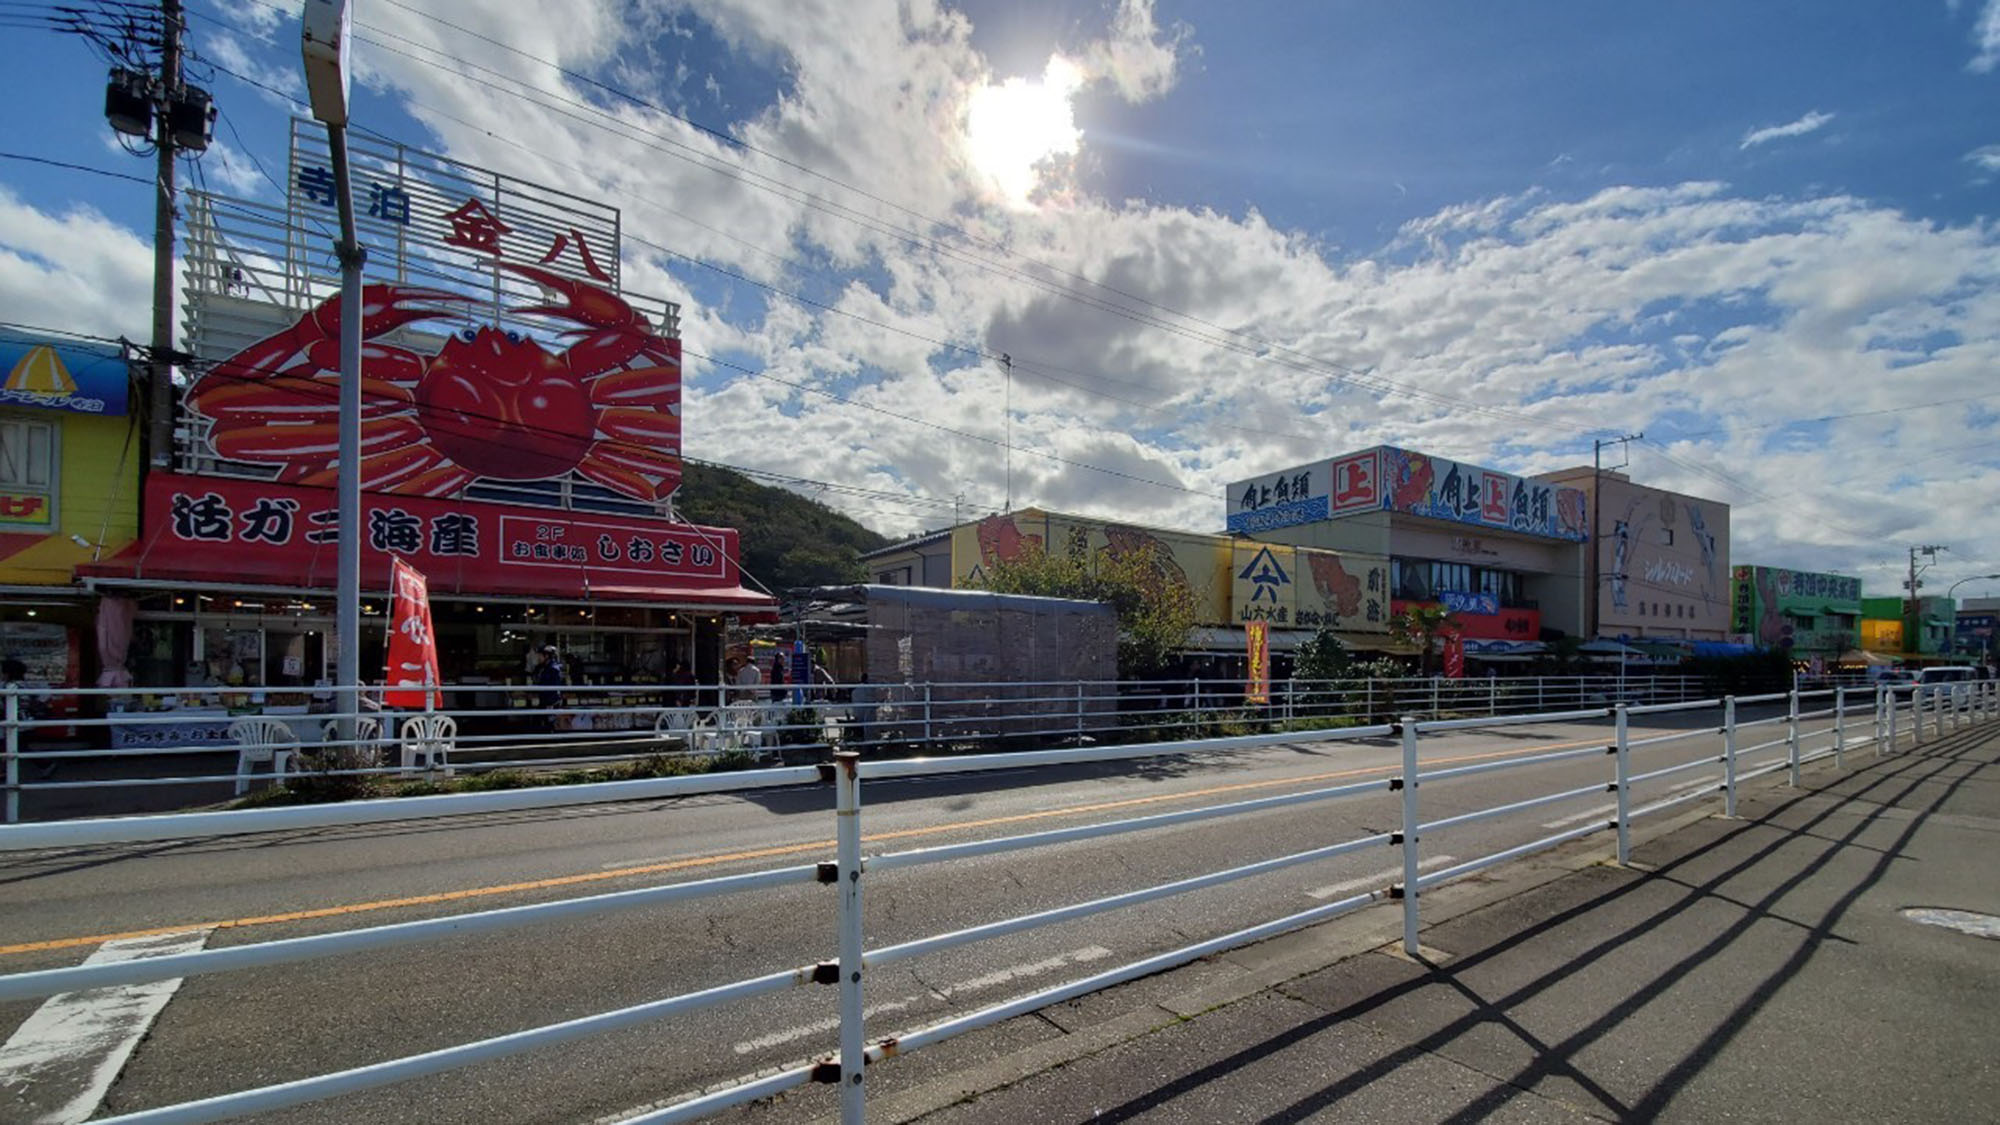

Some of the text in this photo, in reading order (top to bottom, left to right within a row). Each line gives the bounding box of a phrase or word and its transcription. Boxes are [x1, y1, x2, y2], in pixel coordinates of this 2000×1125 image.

[297, 166, 613, 283] 寺泊 金八
[535, 525, 565, 541] 2F
[512, 541, 588, 562] お食事処
[596, 534, 715, 567] しおさい
[1240, 604, 1289, 623] 山六水産
